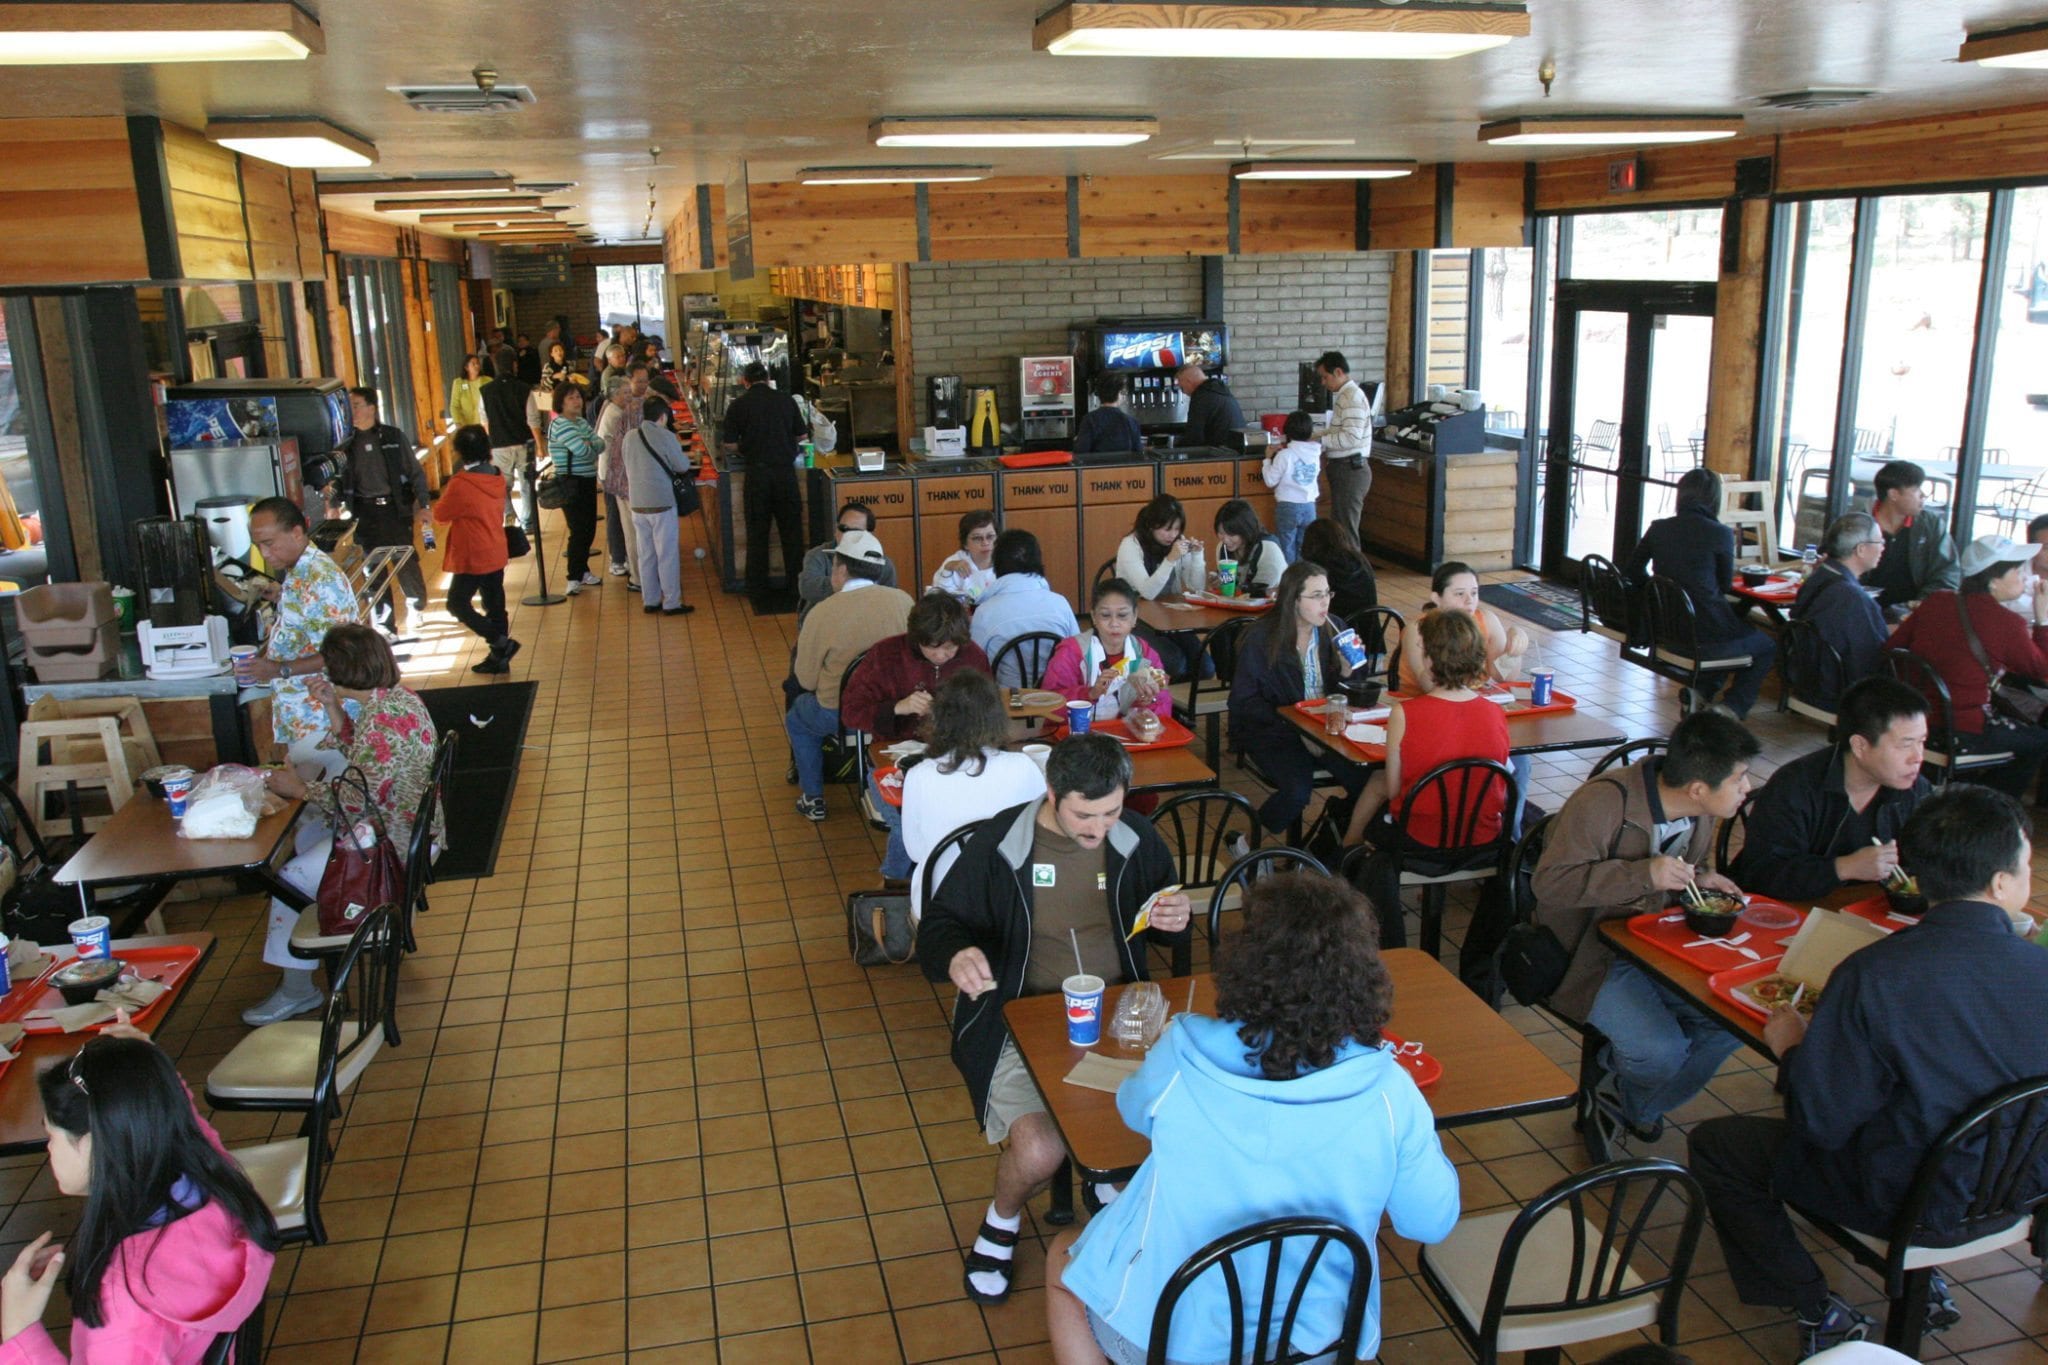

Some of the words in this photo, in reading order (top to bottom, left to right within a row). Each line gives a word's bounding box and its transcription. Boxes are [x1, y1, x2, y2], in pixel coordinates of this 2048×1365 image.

[1107, 334, 1173, 364] PEPSI
[1173, 476, 1203, 487] THANK
[1207, 474, 1227, 485] YOU
[1247, 473, 1264, 483] THA
[1012, 485, 1044, 496] THANK
[1048, 483, 1069, 494] YOU
[1090, 481, 1122, 492] THANK
[1126, 479, 1146, 490] YOU
[846, 494, 879, 505] THANK
[883, 492, 905, 504] YOU
[927, 490, 960, 502] THANK
[964, 488, 985, 499] YOU
